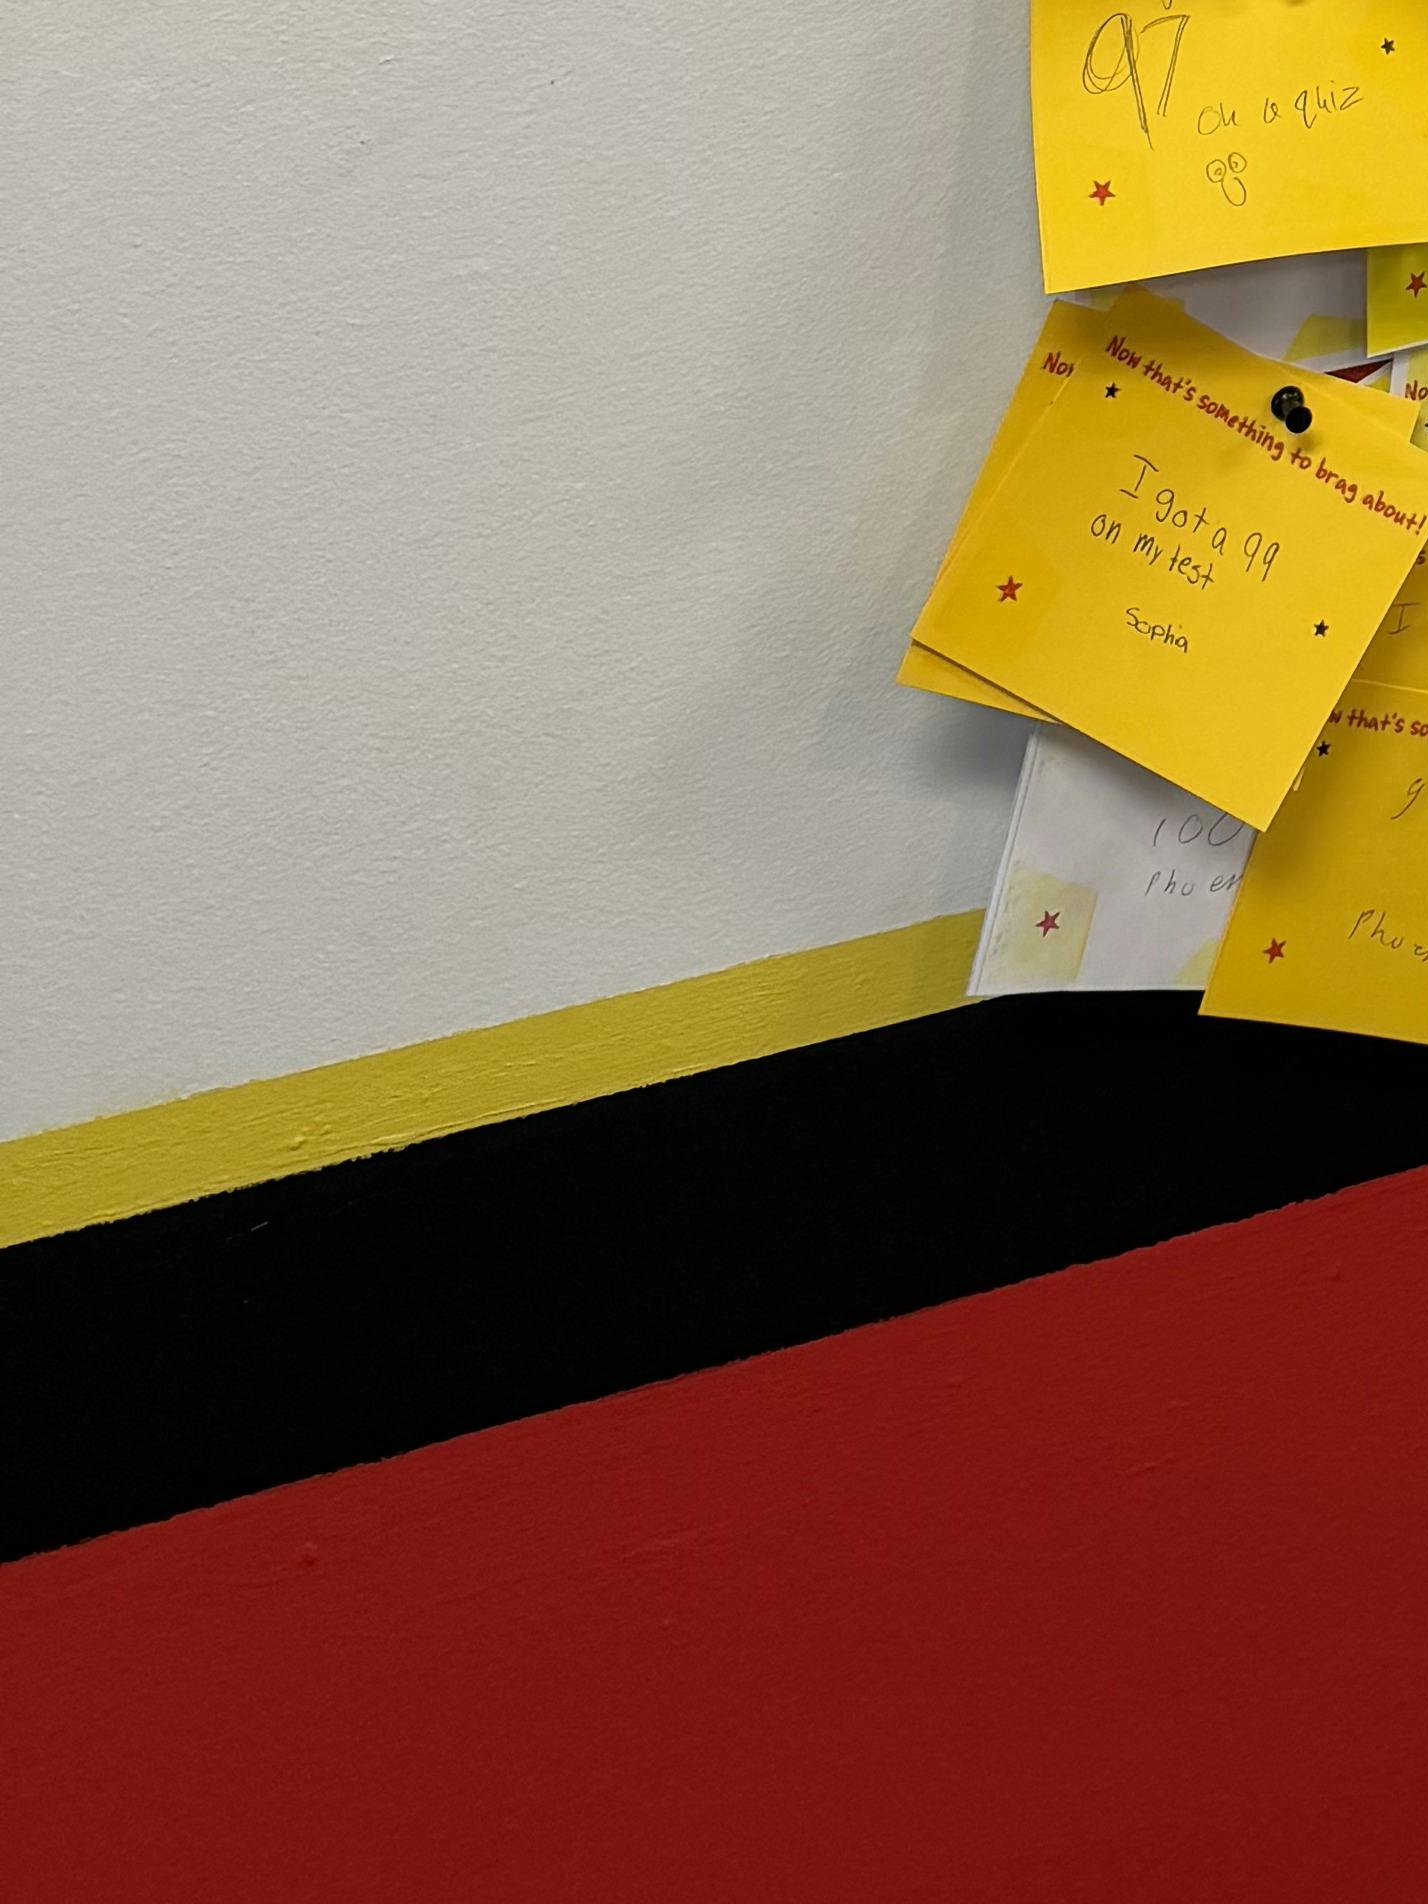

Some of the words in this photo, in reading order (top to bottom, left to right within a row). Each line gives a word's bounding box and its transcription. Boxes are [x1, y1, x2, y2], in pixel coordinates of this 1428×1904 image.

[1105, 336, 1139, 373] Now
[1142, 360, 1195, 403] that's
[1197, 392, 1284, 461] something
[1289, 447, 1311, 471] to
[1316, 460, 1358, 502] brag
[1361, 488, 1428, 536] about!
[1091, 513, 1123, 546] on
[1133, 528, 1166, 566] my
[1169, 546, 1214, 591] test
[1118, 453, 1158, 499] I
[1156, 486, 1211, 534] got
[1211, 530, 1226, 553] a
[1242, 533, 1280, 583] 99
